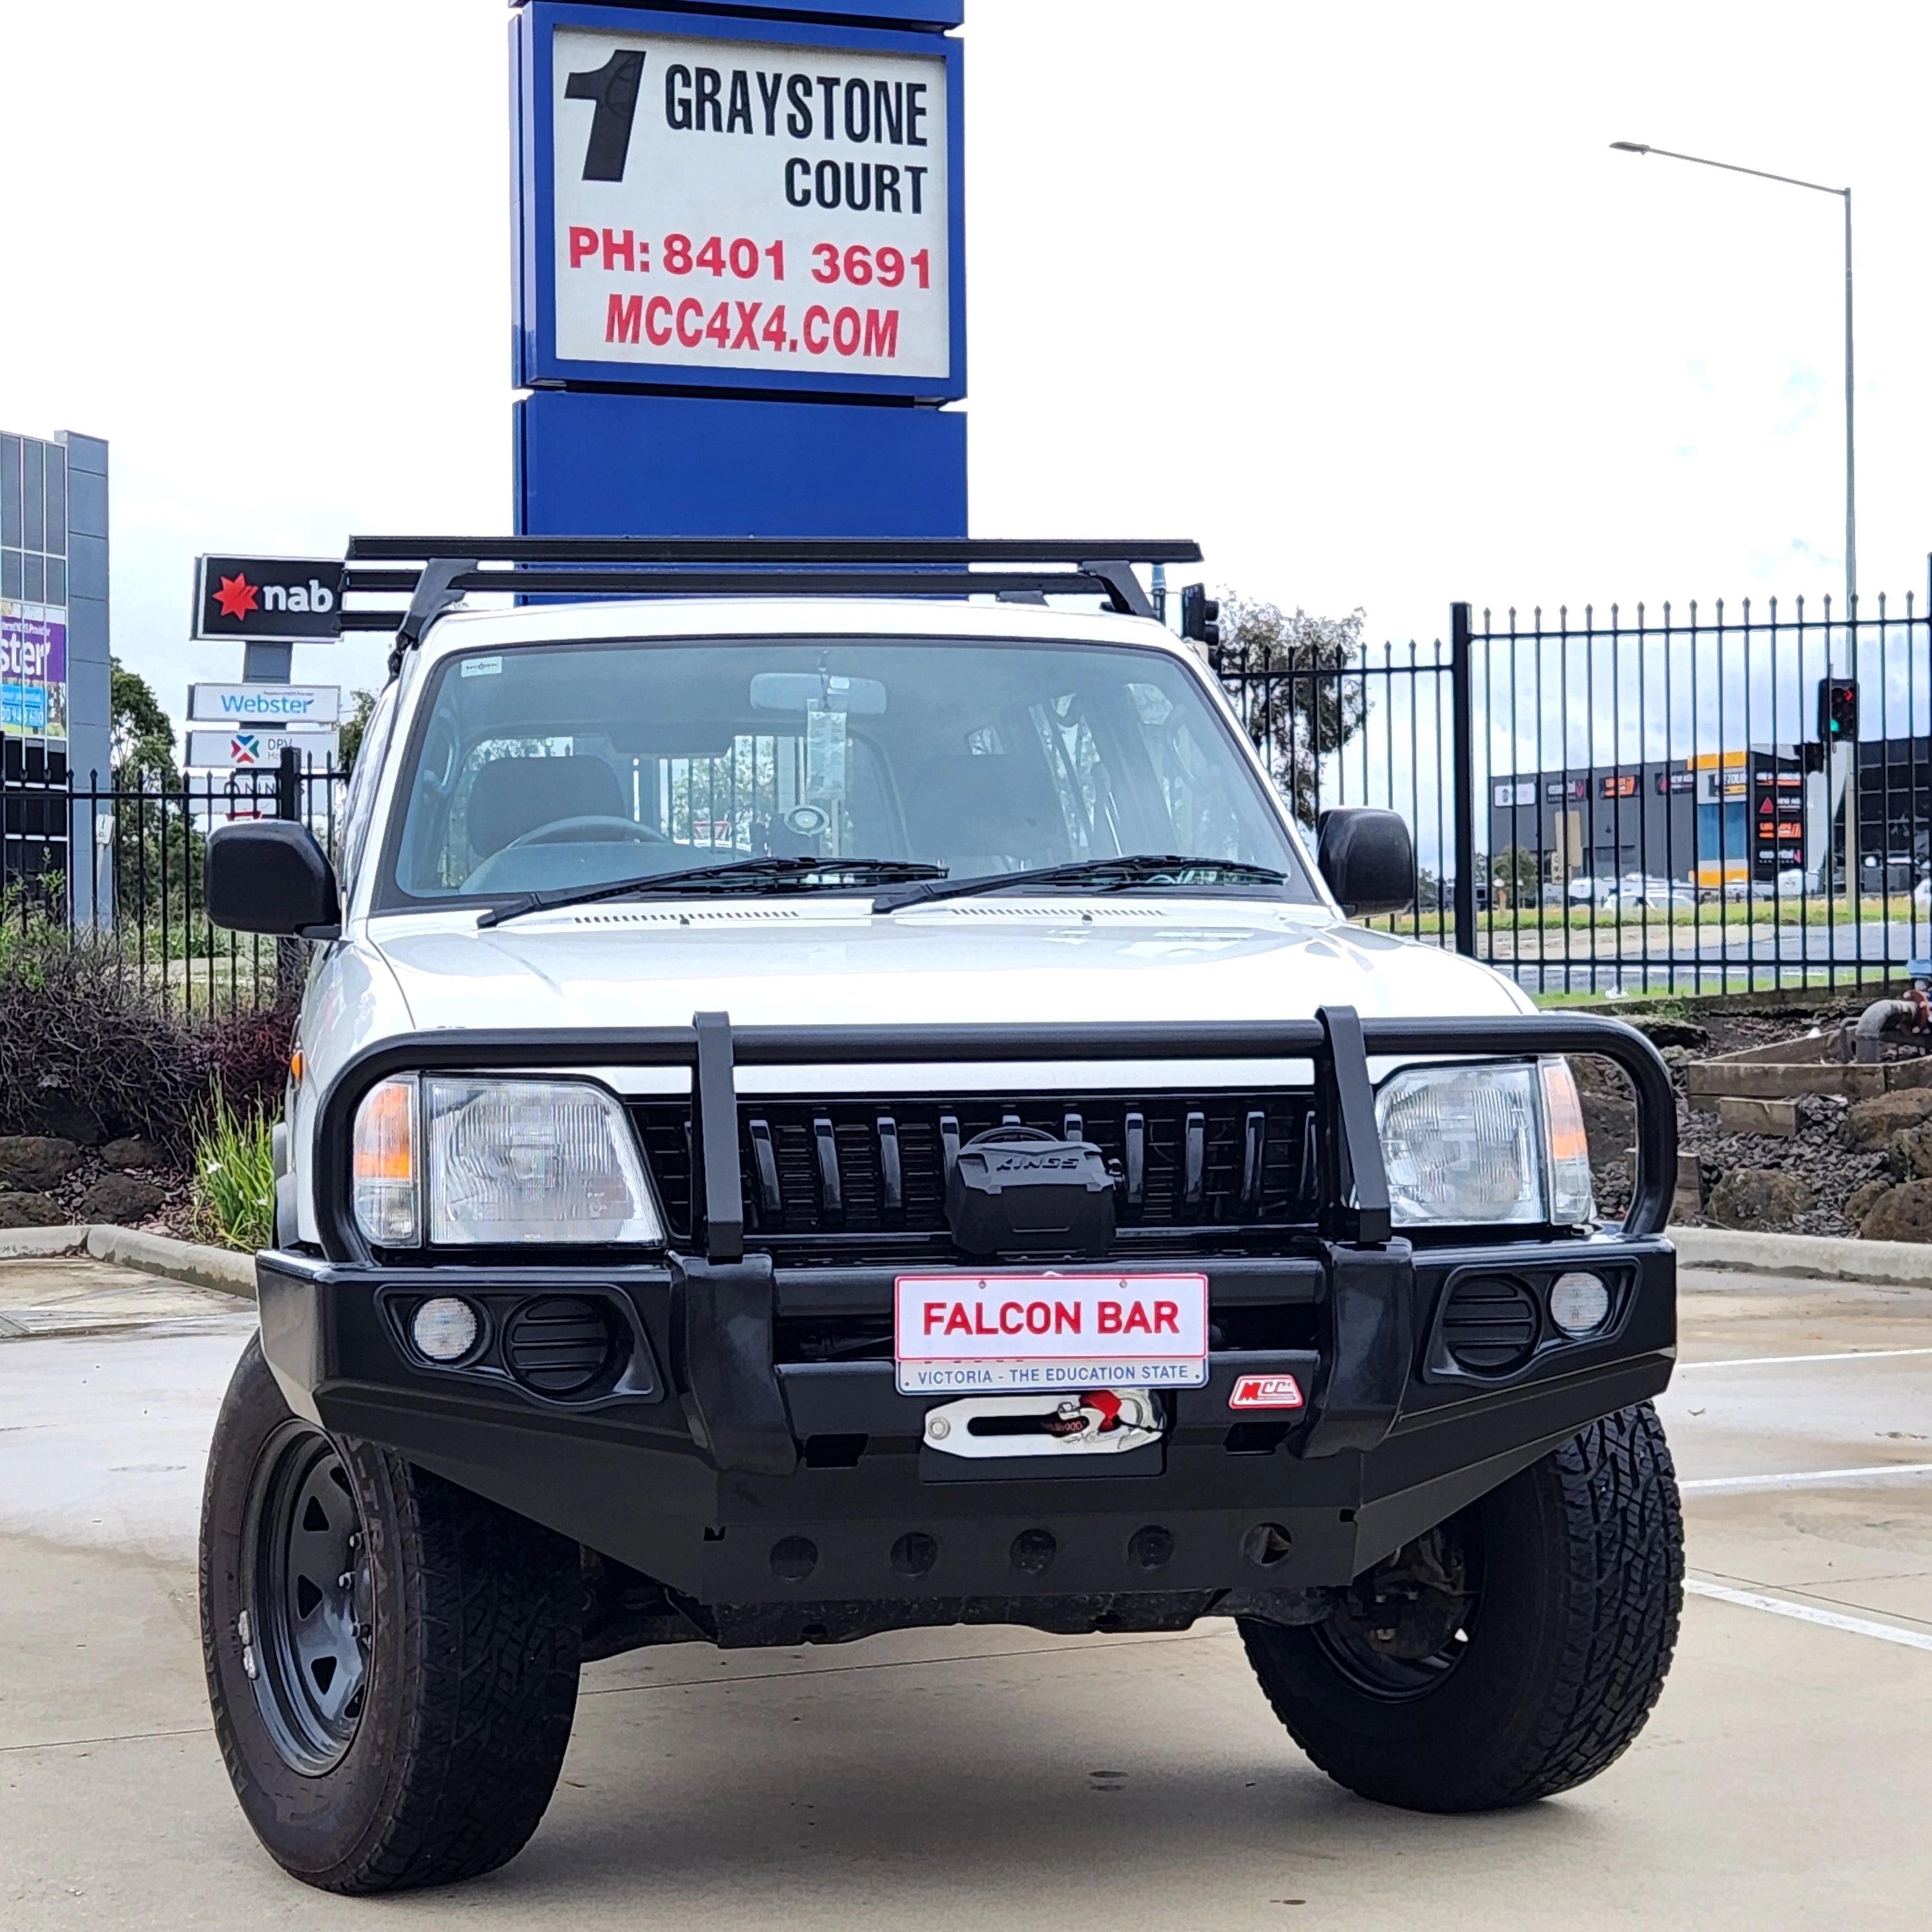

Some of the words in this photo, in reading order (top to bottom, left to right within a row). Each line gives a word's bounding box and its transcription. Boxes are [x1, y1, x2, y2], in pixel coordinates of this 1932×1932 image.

[564, 50, 646, 182] 1
[666, 64, 928, 147] GRAYSTONE
[785, 157, 928, 214] COURT
[569, 226, 650, 272] PH:
[663, 233, 784, 280] 8401
[812, 243, 929, 289] 3691
[606, 294, 899, 357] MCC4X4.COM
[263, 579, 333, 613] nab
[220, 694, 314, 714] Webster
[996, 1158, 1079, 1171] KINGS
[923, 1300, 1082, 1335] FALCON
[1097, 1300, 1179, 1334] BAR
[918, 1370, 992, 1385] VICTORIA
[1009, 1368, 1040, 1382] THE
[1046, 1366, 1135, 1381] EDUCATION
[1141, 1365, 1188, 1379] STATE
